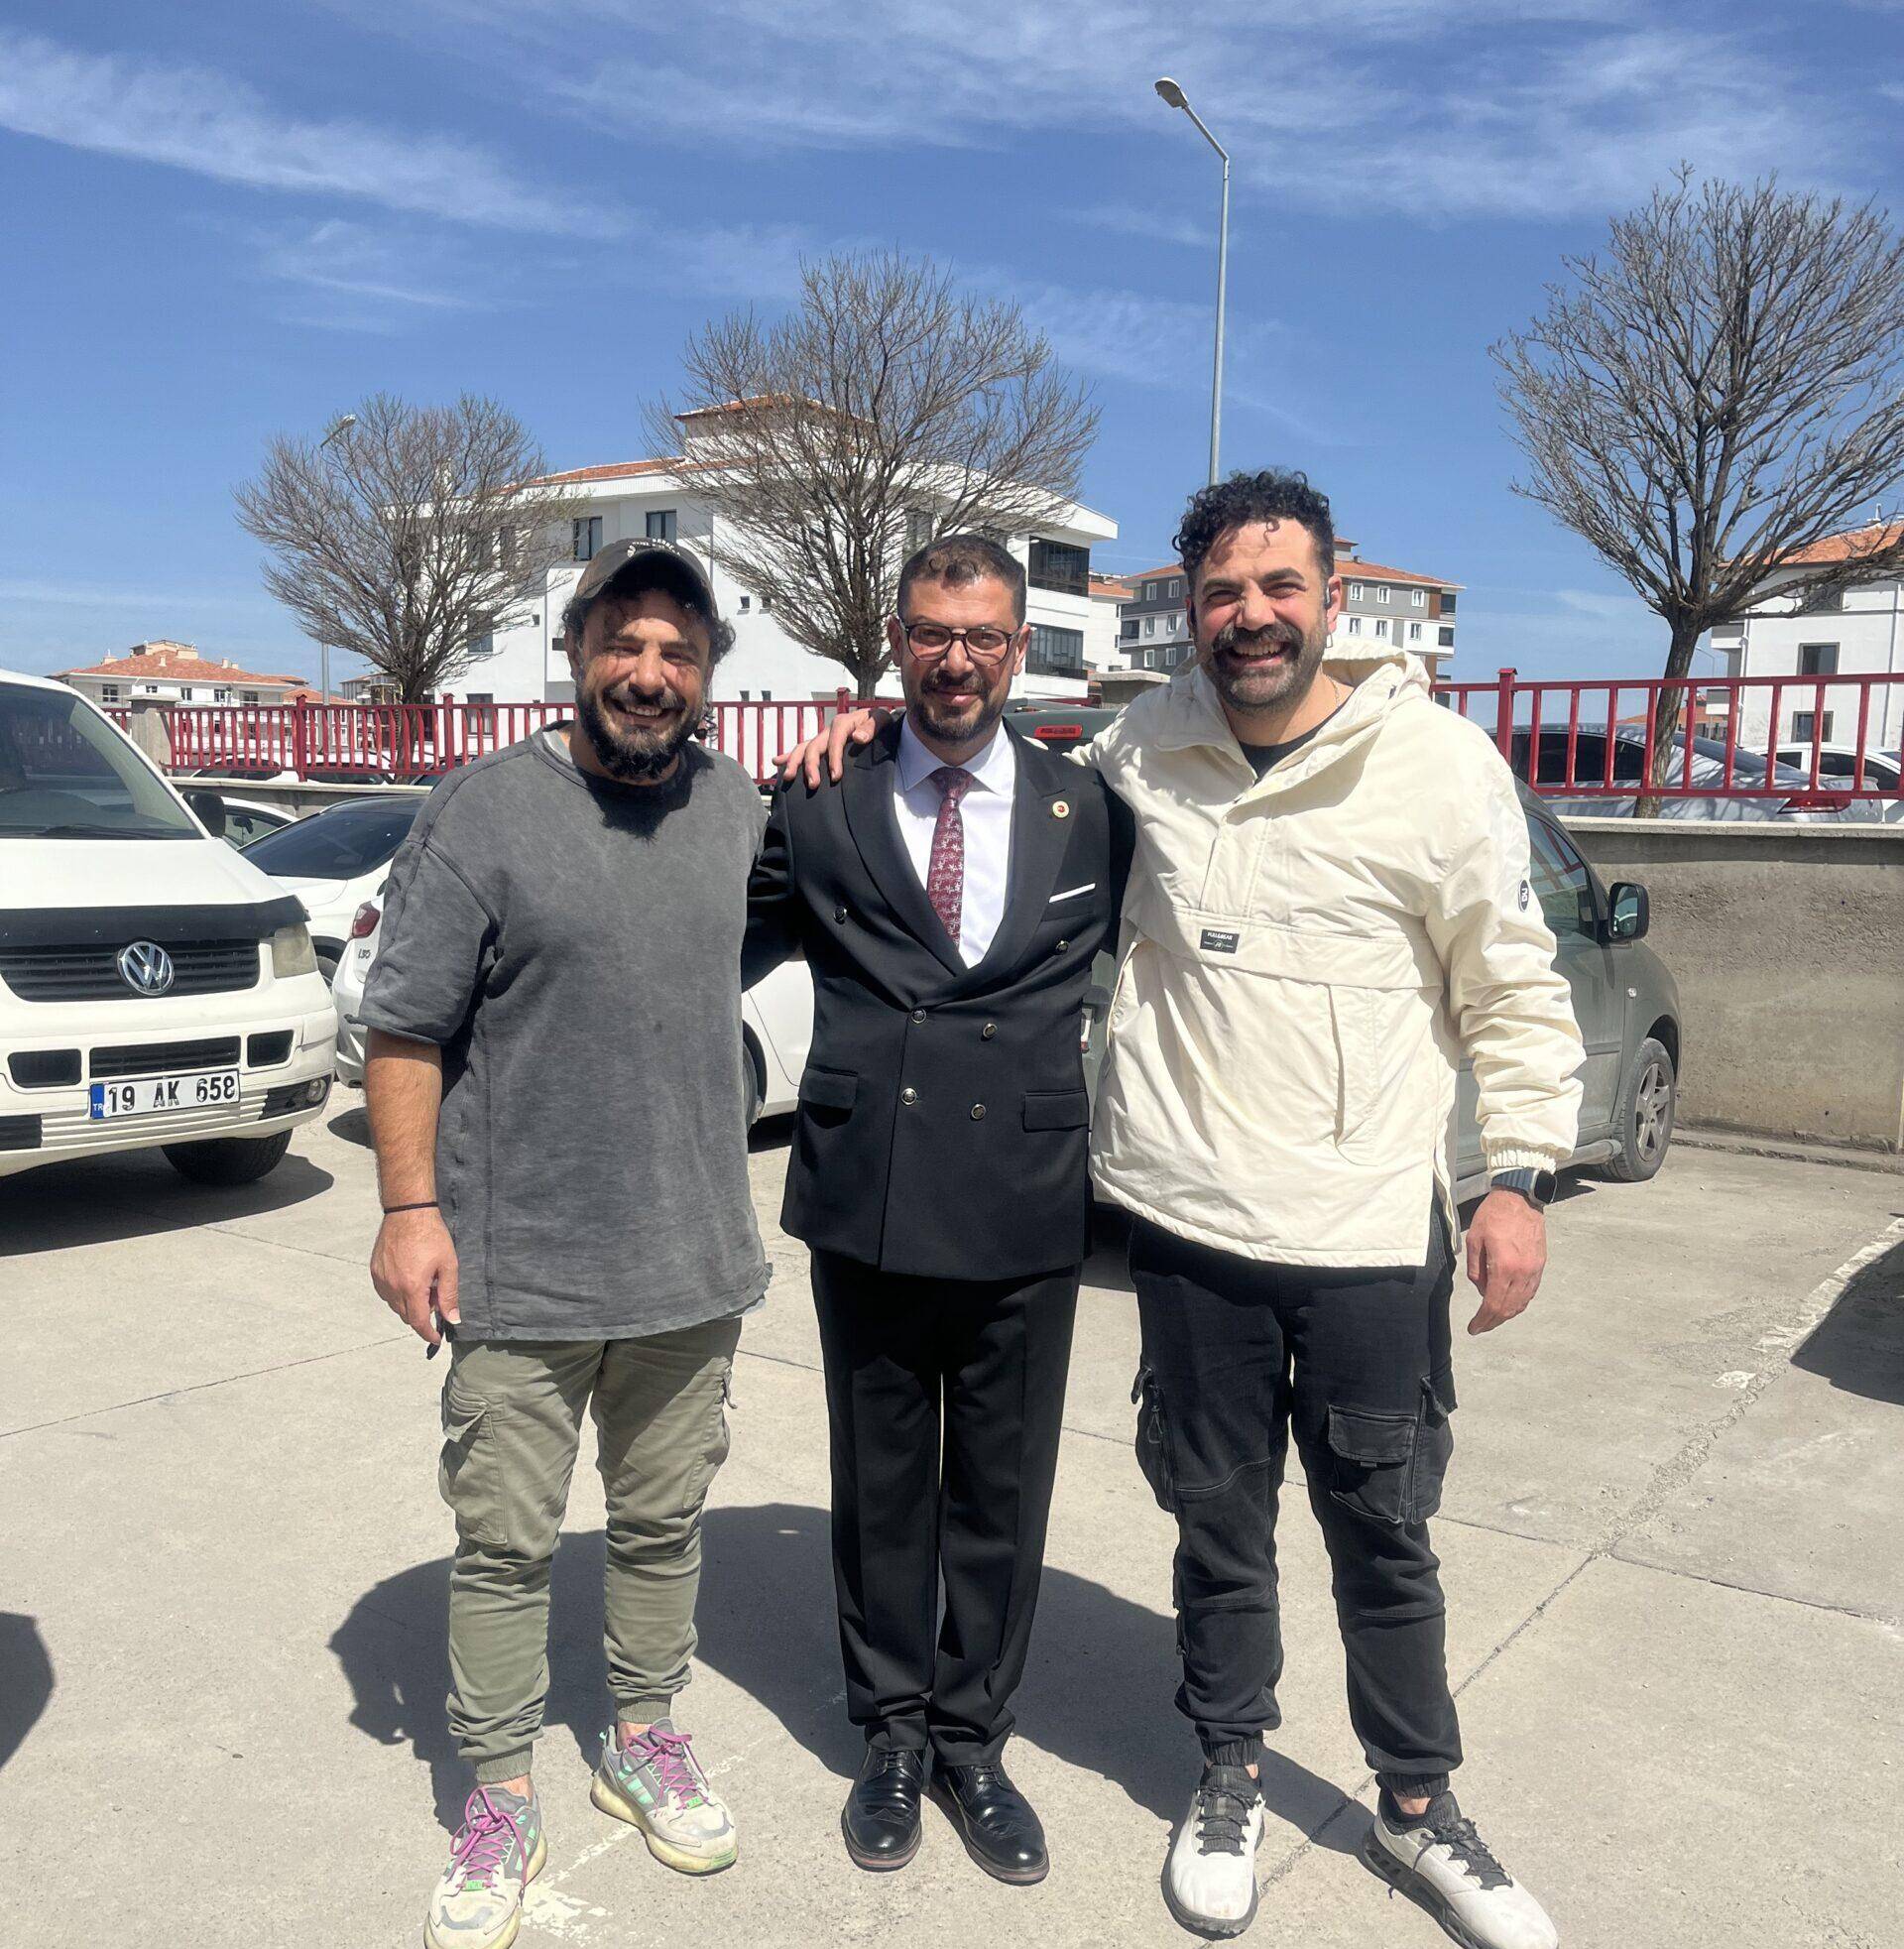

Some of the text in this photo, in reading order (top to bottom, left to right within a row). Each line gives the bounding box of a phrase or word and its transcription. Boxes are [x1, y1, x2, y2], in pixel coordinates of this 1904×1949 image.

[108, 1075, 235, 1113] 19 AK 658
